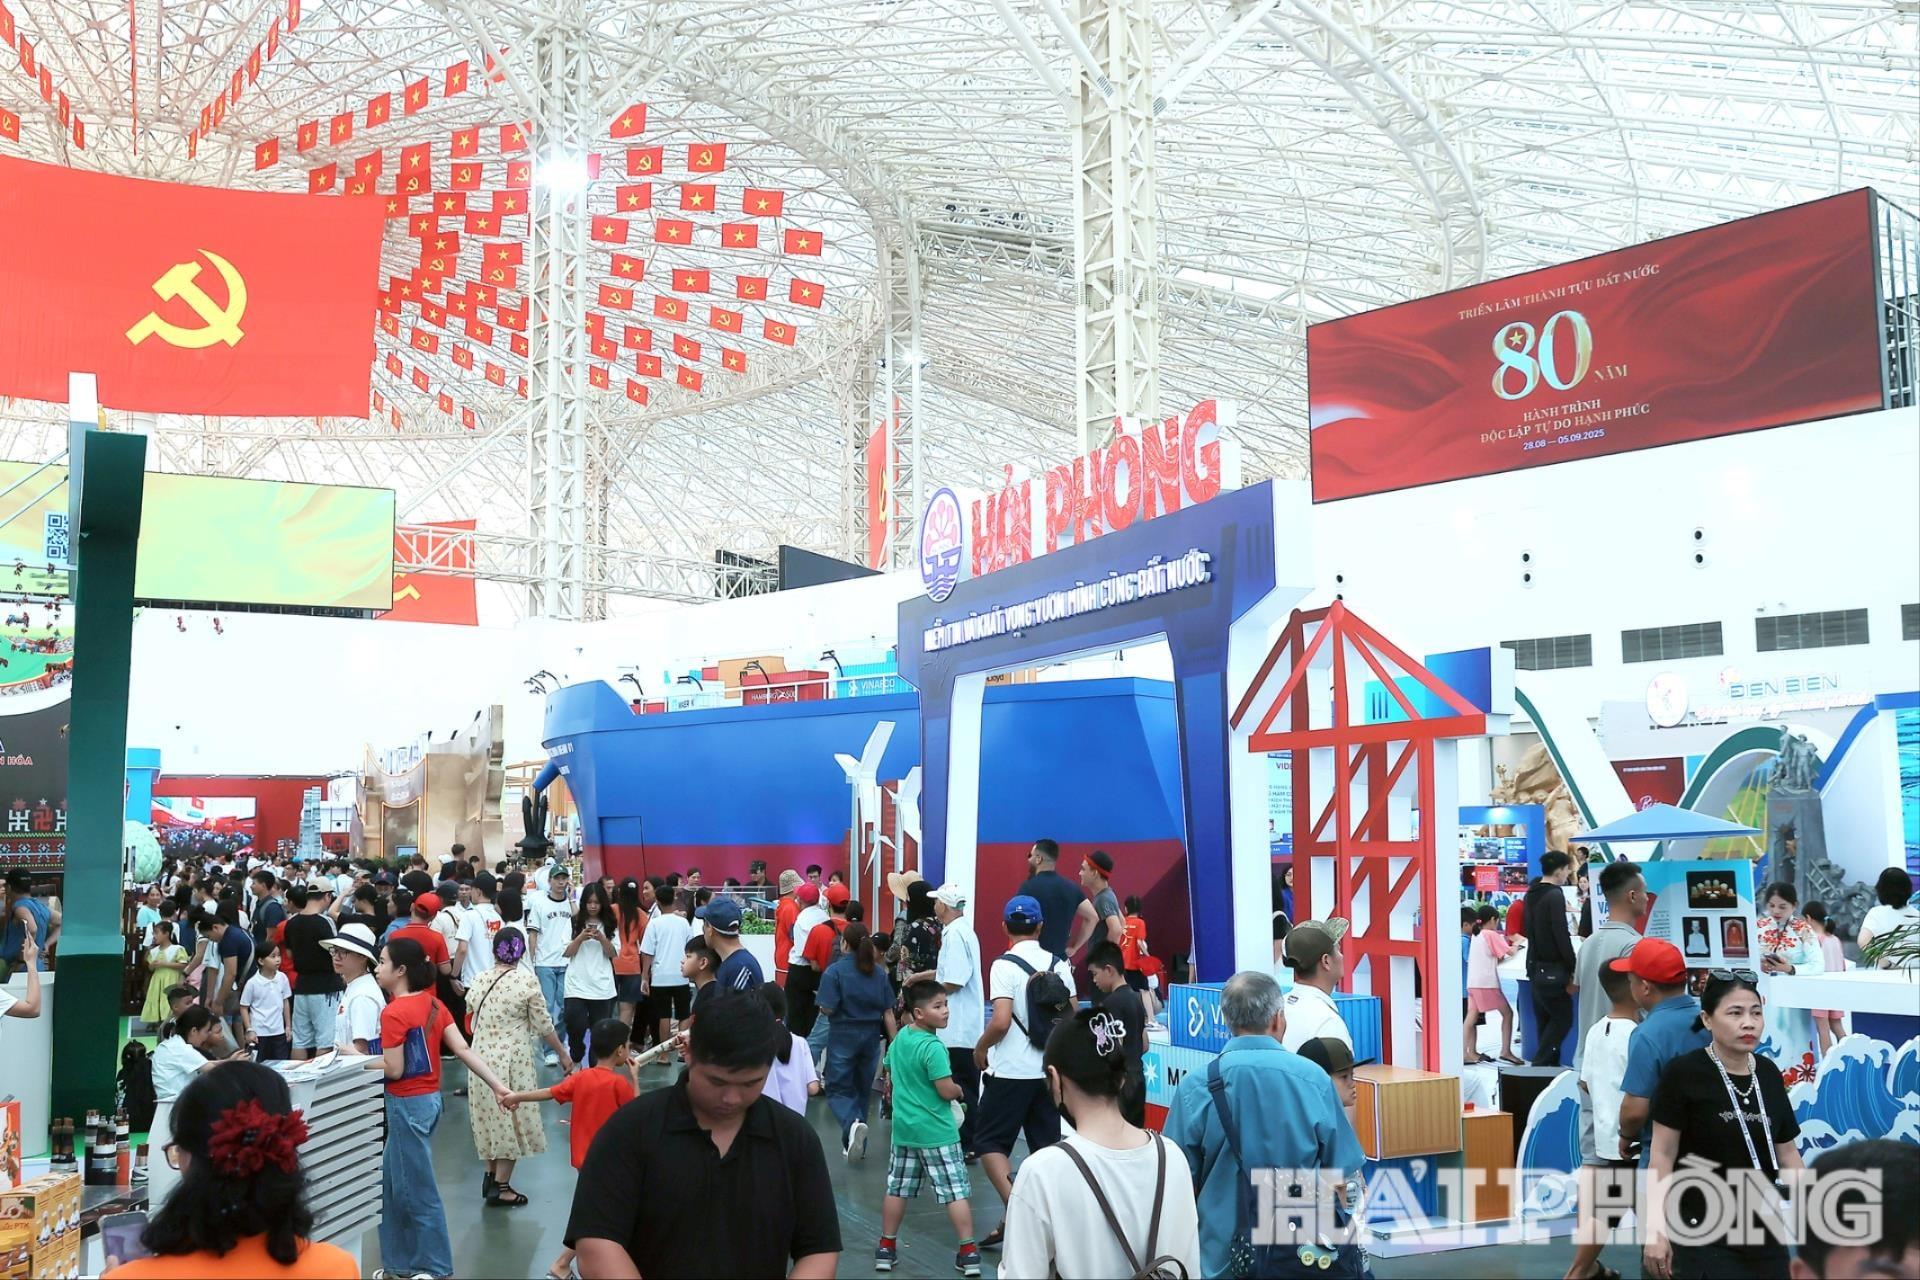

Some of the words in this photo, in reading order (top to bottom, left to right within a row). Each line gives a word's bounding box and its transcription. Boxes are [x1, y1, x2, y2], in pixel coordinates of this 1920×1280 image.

[1495, 295, 1521, 313] LÃM
[1524, 286, 1566, 305] THÀNH
[1596, 271, 1621, 290] ĐẤT
[1623, 262, 1660, 282] NƯỚC
[1491, 309, 1593, 401] 80
[1594, 363, 1629, 384] NĂM
[1480, 427, 1506, 444] ĐỘC
[1507, 423, 1532, 439] LẬP
[1534, 420, 1552, 435] TỰ
[1553, 418, 1572, 431] DO
[1574, 411, 1613, 427] HẠNH
[1614, 403, 1650, 420] PHÚC
[1523, 403, 1560, 422] HÀNH
[1561, 398, 1601, 416] TRÌNH
[1523, 438, 1547, 451] 28.08
[1558, 428, 1605, 445] 05.09.2025
[971, 464, 1033, 578] HẢI
[1046, 399, 1221, 554] PHÒNG
[1068, 579, 1098, 616] MÌNH
[1099, 570, 1137, 608] CÙNG
[1138, 553, 1167, 598] ĐẤT
[1167, 547, 1212, 590] NƯỚC
[7, 753, 34, 766] HÓA
